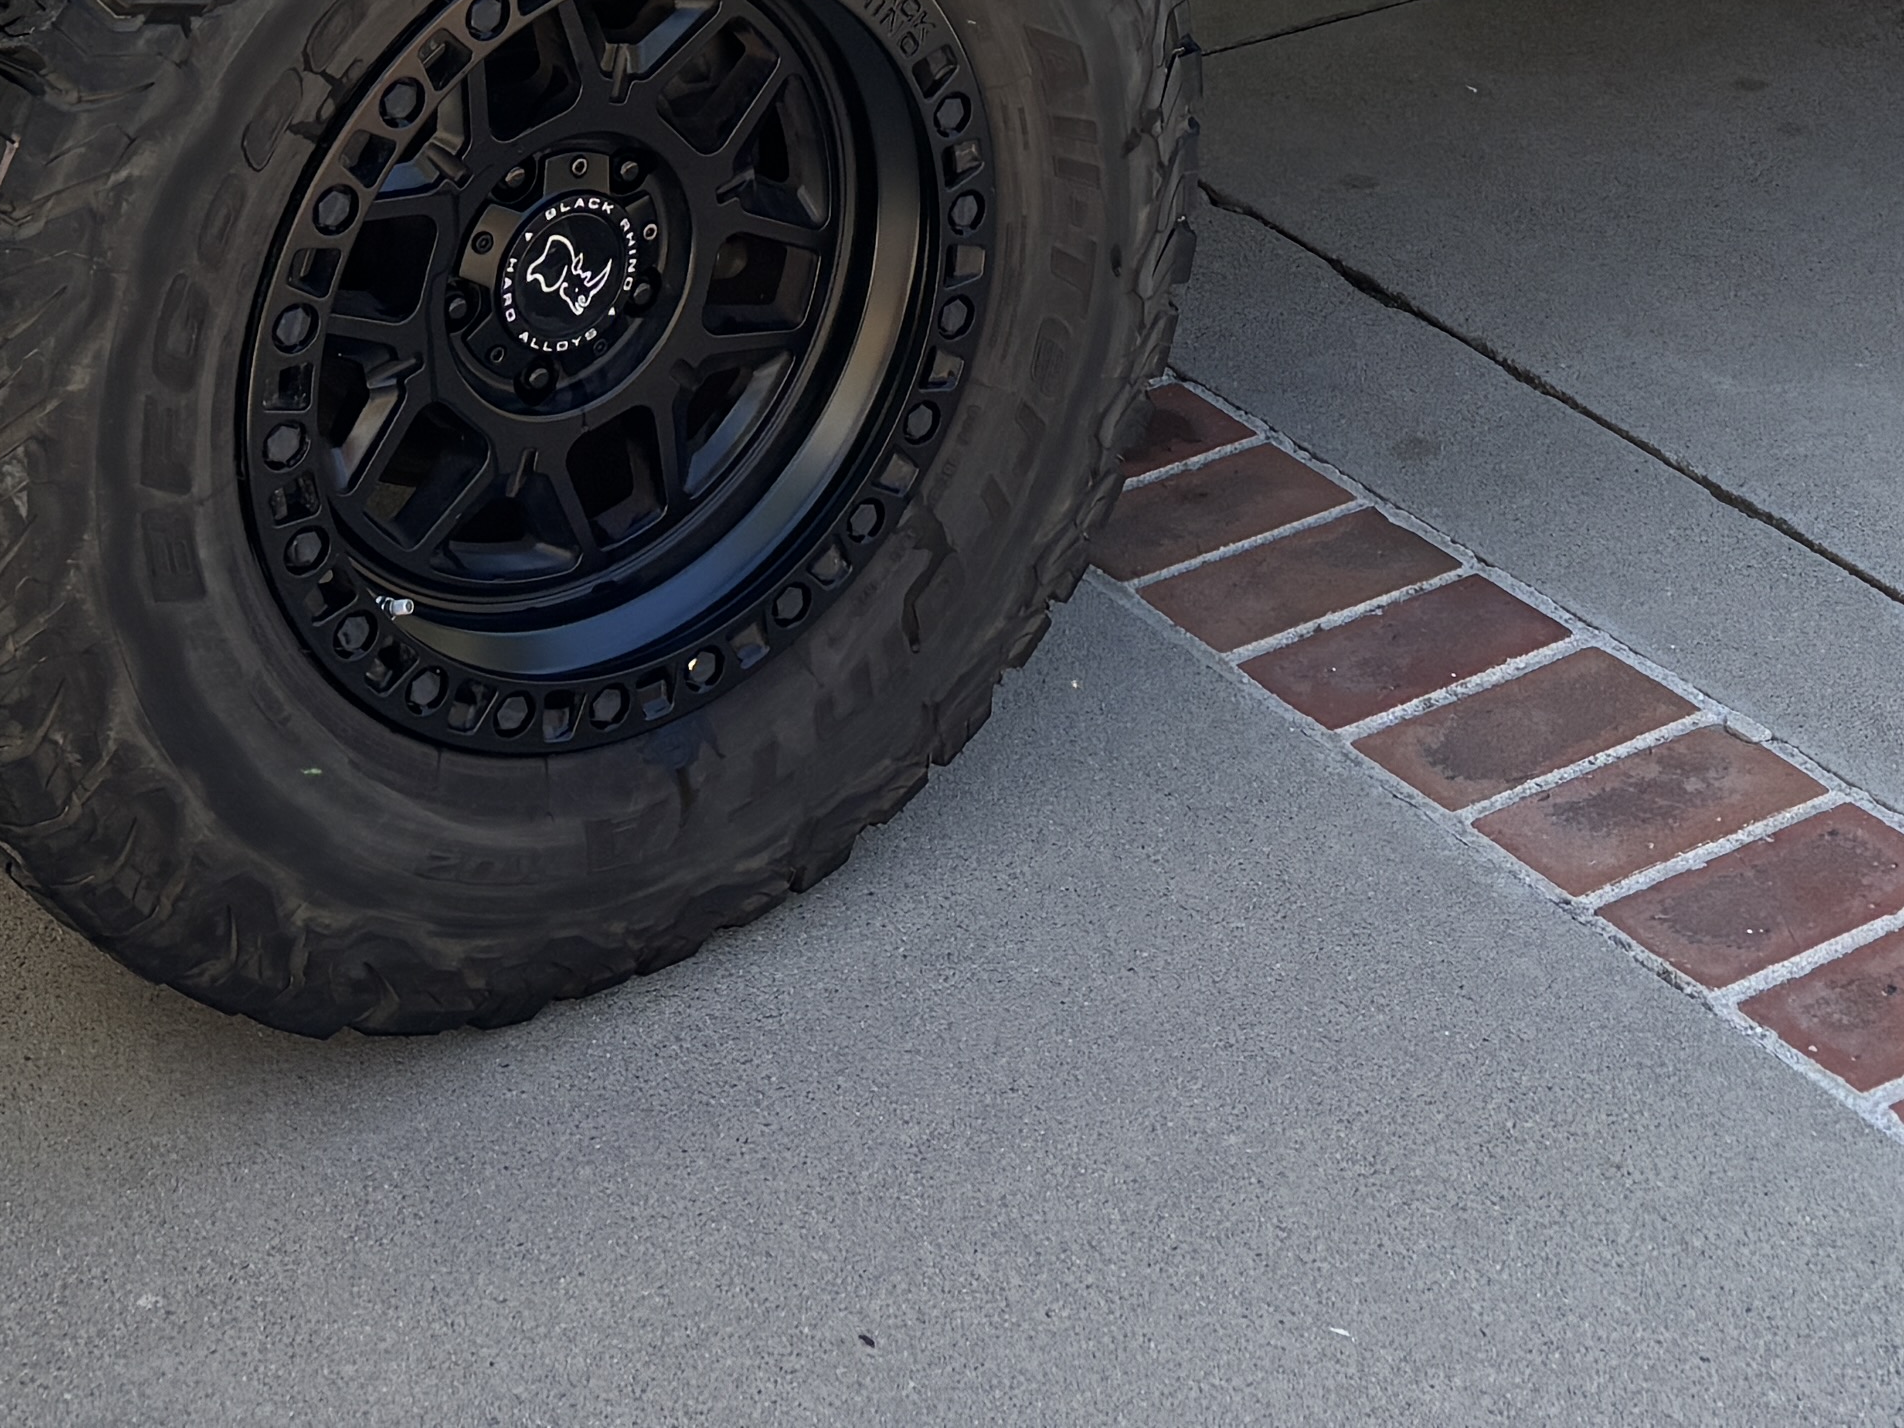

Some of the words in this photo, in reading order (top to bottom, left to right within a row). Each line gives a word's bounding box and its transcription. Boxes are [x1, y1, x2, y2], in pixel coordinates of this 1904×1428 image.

[545, 198, 614, 221] BLACK
[619, 218, 637, 291] RHINO
[502, 257, 517, 322] HARD
[518, 328, 598, 352] ALLOYS
